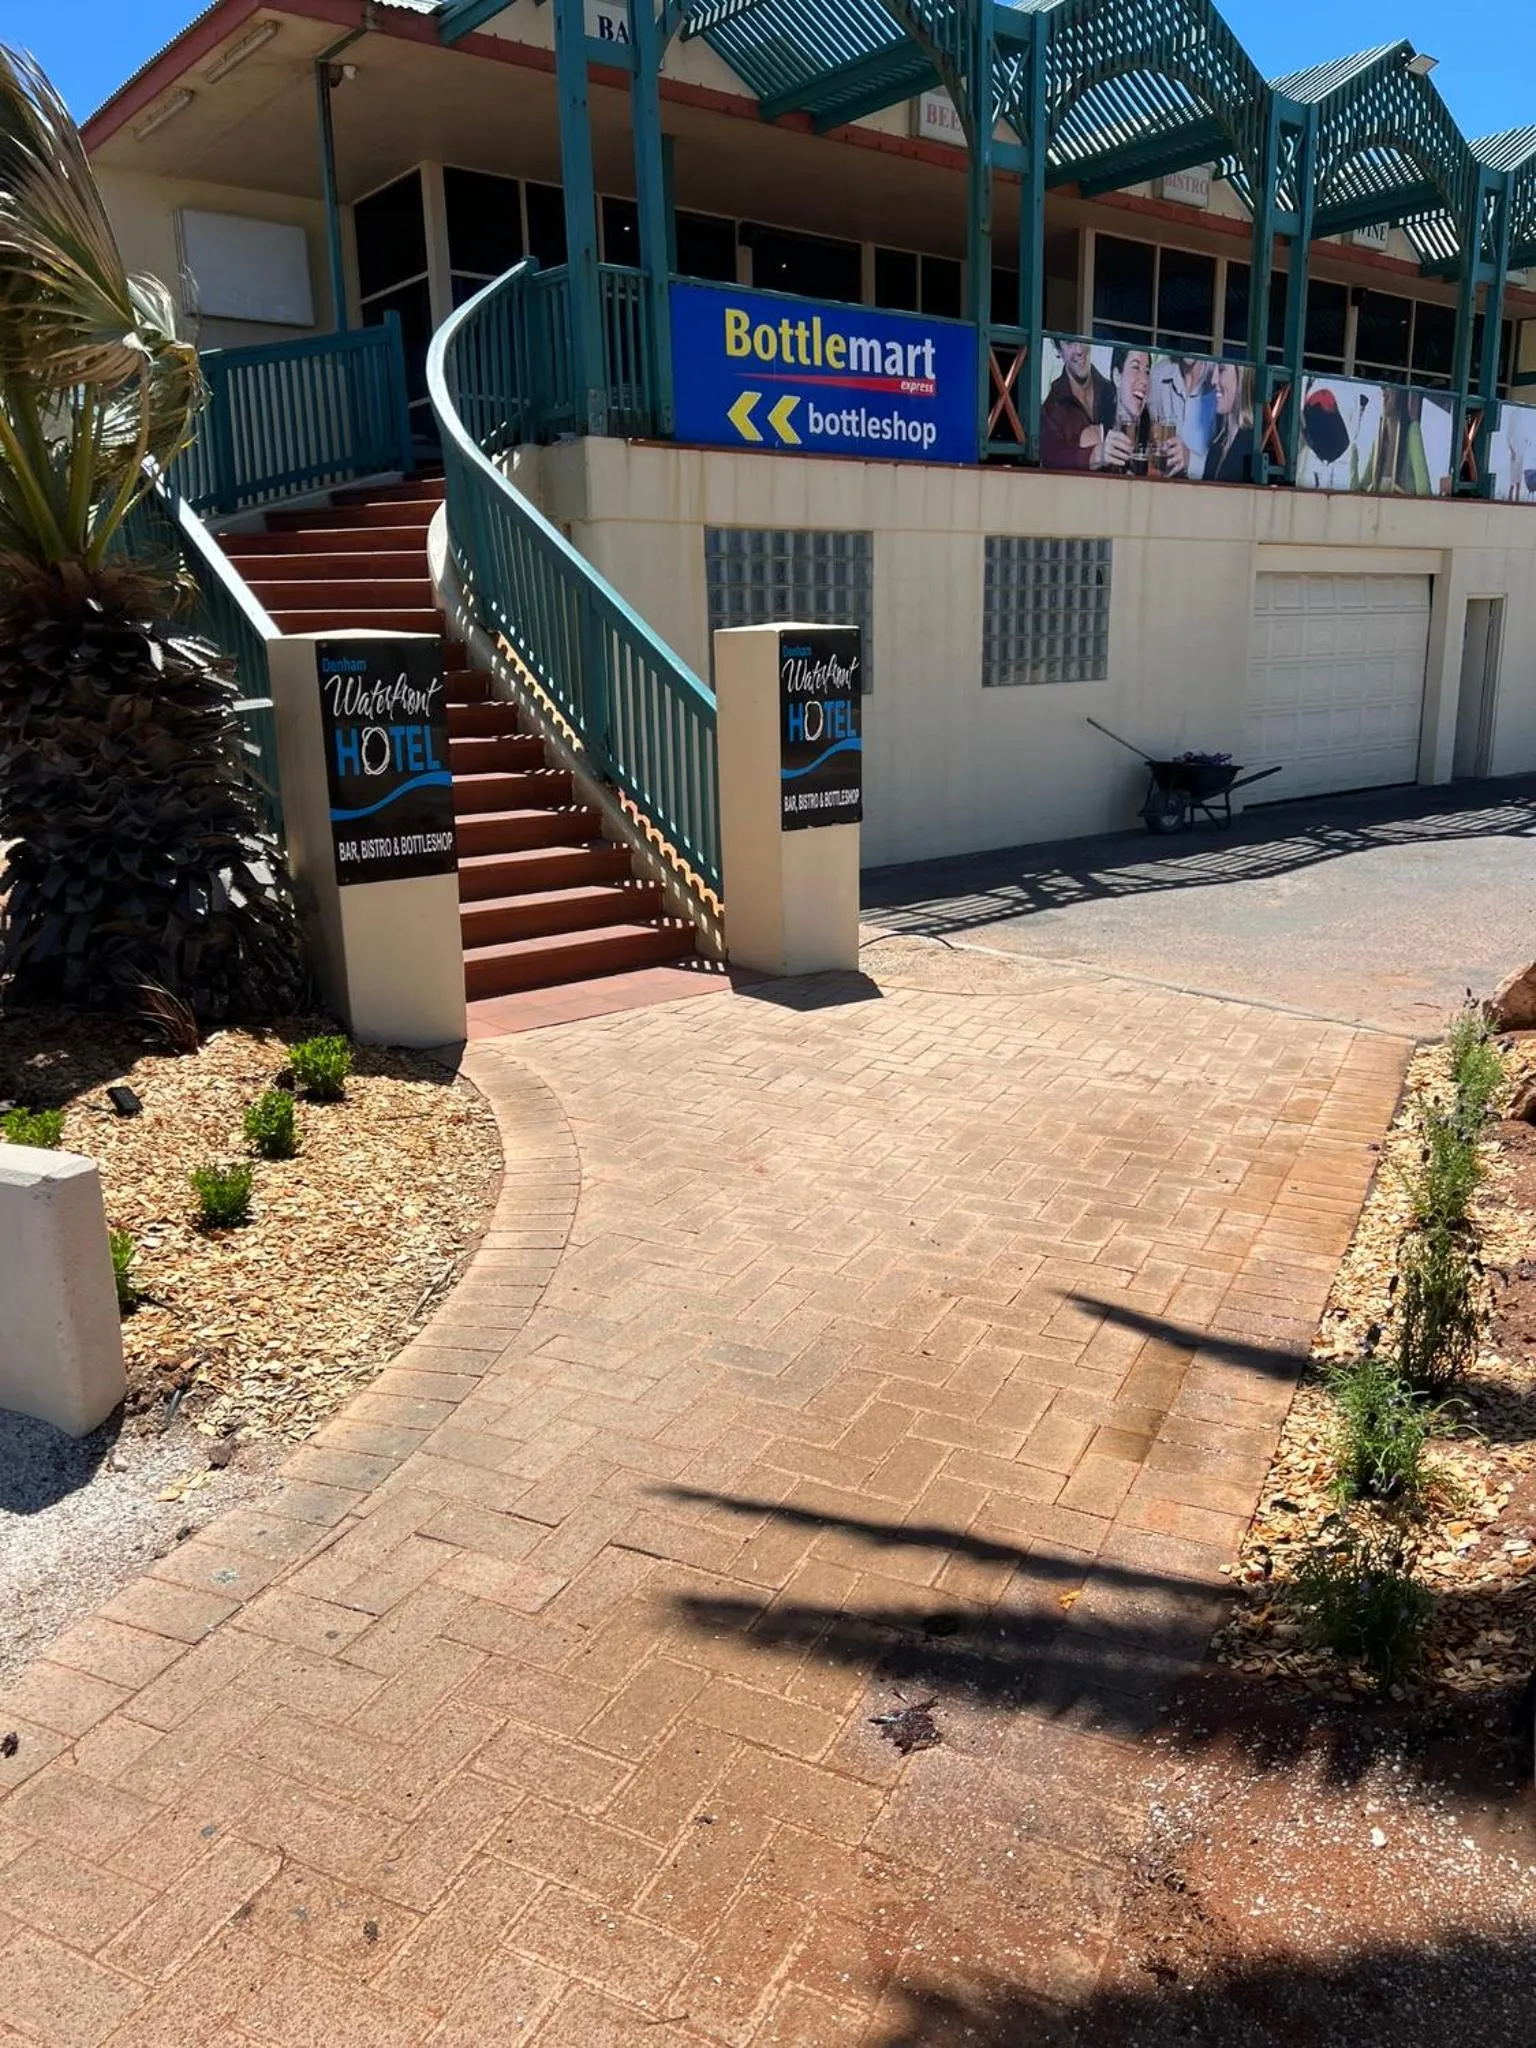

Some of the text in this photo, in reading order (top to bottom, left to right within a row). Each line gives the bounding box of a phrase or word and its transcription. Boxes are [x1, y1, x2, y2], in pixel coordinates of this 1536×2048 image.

[597, 14, 629, 44] BA
[926, 104, 961, 131] BEE
[725, 308, 936, 379] Bottlemart
[900, 380, 934, 394] express
[808, 403, 937, 450] bottleshop
[321, 658, 367, 672] Denham
[324, 672, 443, 721] Waterfront
[788, 700, 857, 742] HOTEL
[336, 724, 441, 777] HOTEL
[784, 796, 798, 813] BAR,
[798, 793, 819, 810] BISTRO
[825, 788, 860, 806] BOTTLESHOP
[339, 832, 454, 862] BAR, BISTRO & BOTTLESHOP
